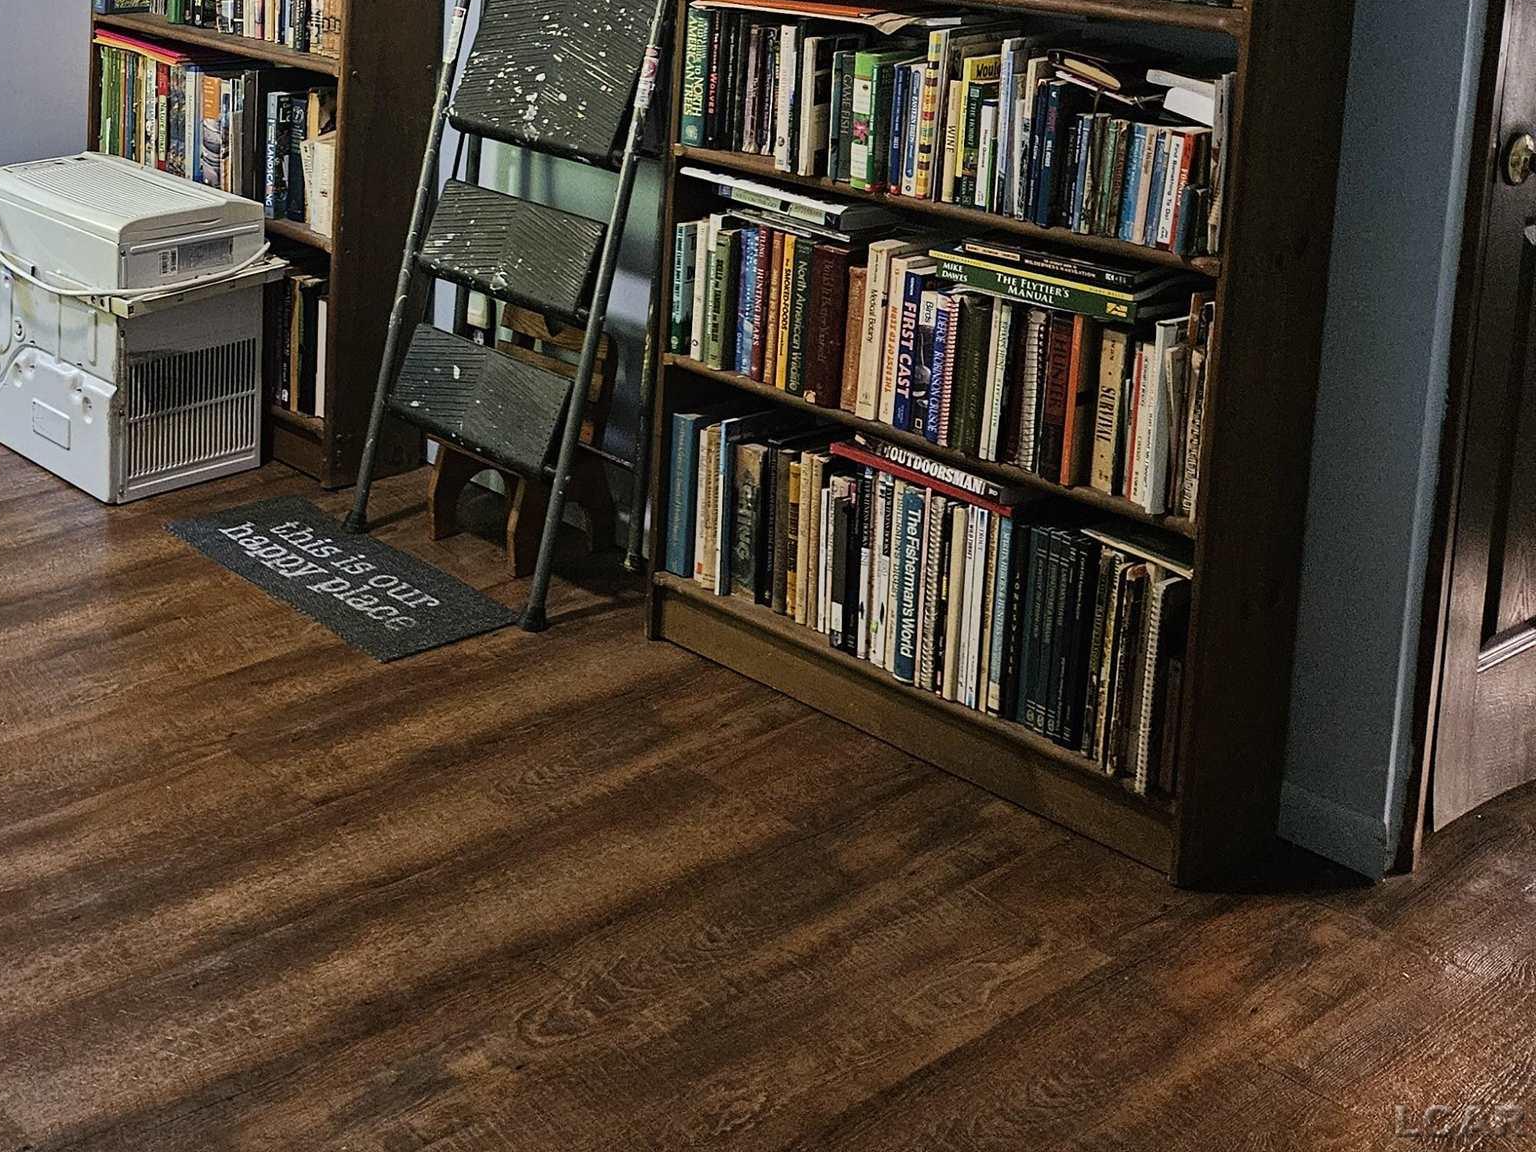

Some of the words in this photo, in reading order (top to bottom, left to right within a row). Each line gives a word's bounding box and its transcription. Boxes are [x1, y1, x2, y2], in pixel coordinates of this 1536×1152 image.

[687, 15, 699, 80] AMERICAN
[684, 83, 694, 115] TREES
[692, 76, 705, 117] NORTH
[708, 72, 718, 114] WOLVES
[841, 73, 853, 108] GAME
[839, 109, 851, 135] FISH
[969, 102, 978, 117] THE
[946, 125, 957, 153] WINE
[967, 118, 977, 148] HOBBIT
[1172, 142, 1180, 159] Find
[265, 143, 275, 207] LANDSCANG
[1166, 159, 1178, 197] Something
[796, 260, 809, 291] North
[941, 270, 968, 284] DAWES
[942, 261, 963, 274] MIKE
[753, 267, 765, 313] HUNTING
[780, 267, 791, 331] SMOKED-FOODS
[868, 288, 878, 318] Medical
[995, 272, 1017, 287] THE
[1020, 278, 1072, 300] FLYTIER'S
[1006, 285, 1055, 306] MANUAL
[791, 293, 805, 349] American
[900, 301, 918, 351] FIRST
[924, 300, 934, 323] Birds
[751, 313, 762, 347] BEARS
[866, 317, 877, 343] Botany
[935, 316, 946, 344] DEFOE
[789, 351, 803, 392] Wildlife
[896, 352, 913, 399] CAST
[929, 350, 944, 398] ROBINSON
[927, 397, 940, 433] CRUSOE
[1095, 385, 1117, 442] SURVIVAL
[883, 486, 893, 529] EYEWITNESS
[906, 508, 922, 536] The
[861, 521, 870, 548] BOOKS
[882, 529, 891, 555] BOOKS
[977, 528, 985, 552] TROUT
[218, 521, 329, 579] happy
[309, 577, 418, 632] place
[269, 519, 344, 558] this
[331, 553, 375, 576] is
[367, 573, 440, 609] our
[902, 536, 921, 617] Fisherman's
[899, 617, 915, 658] World
